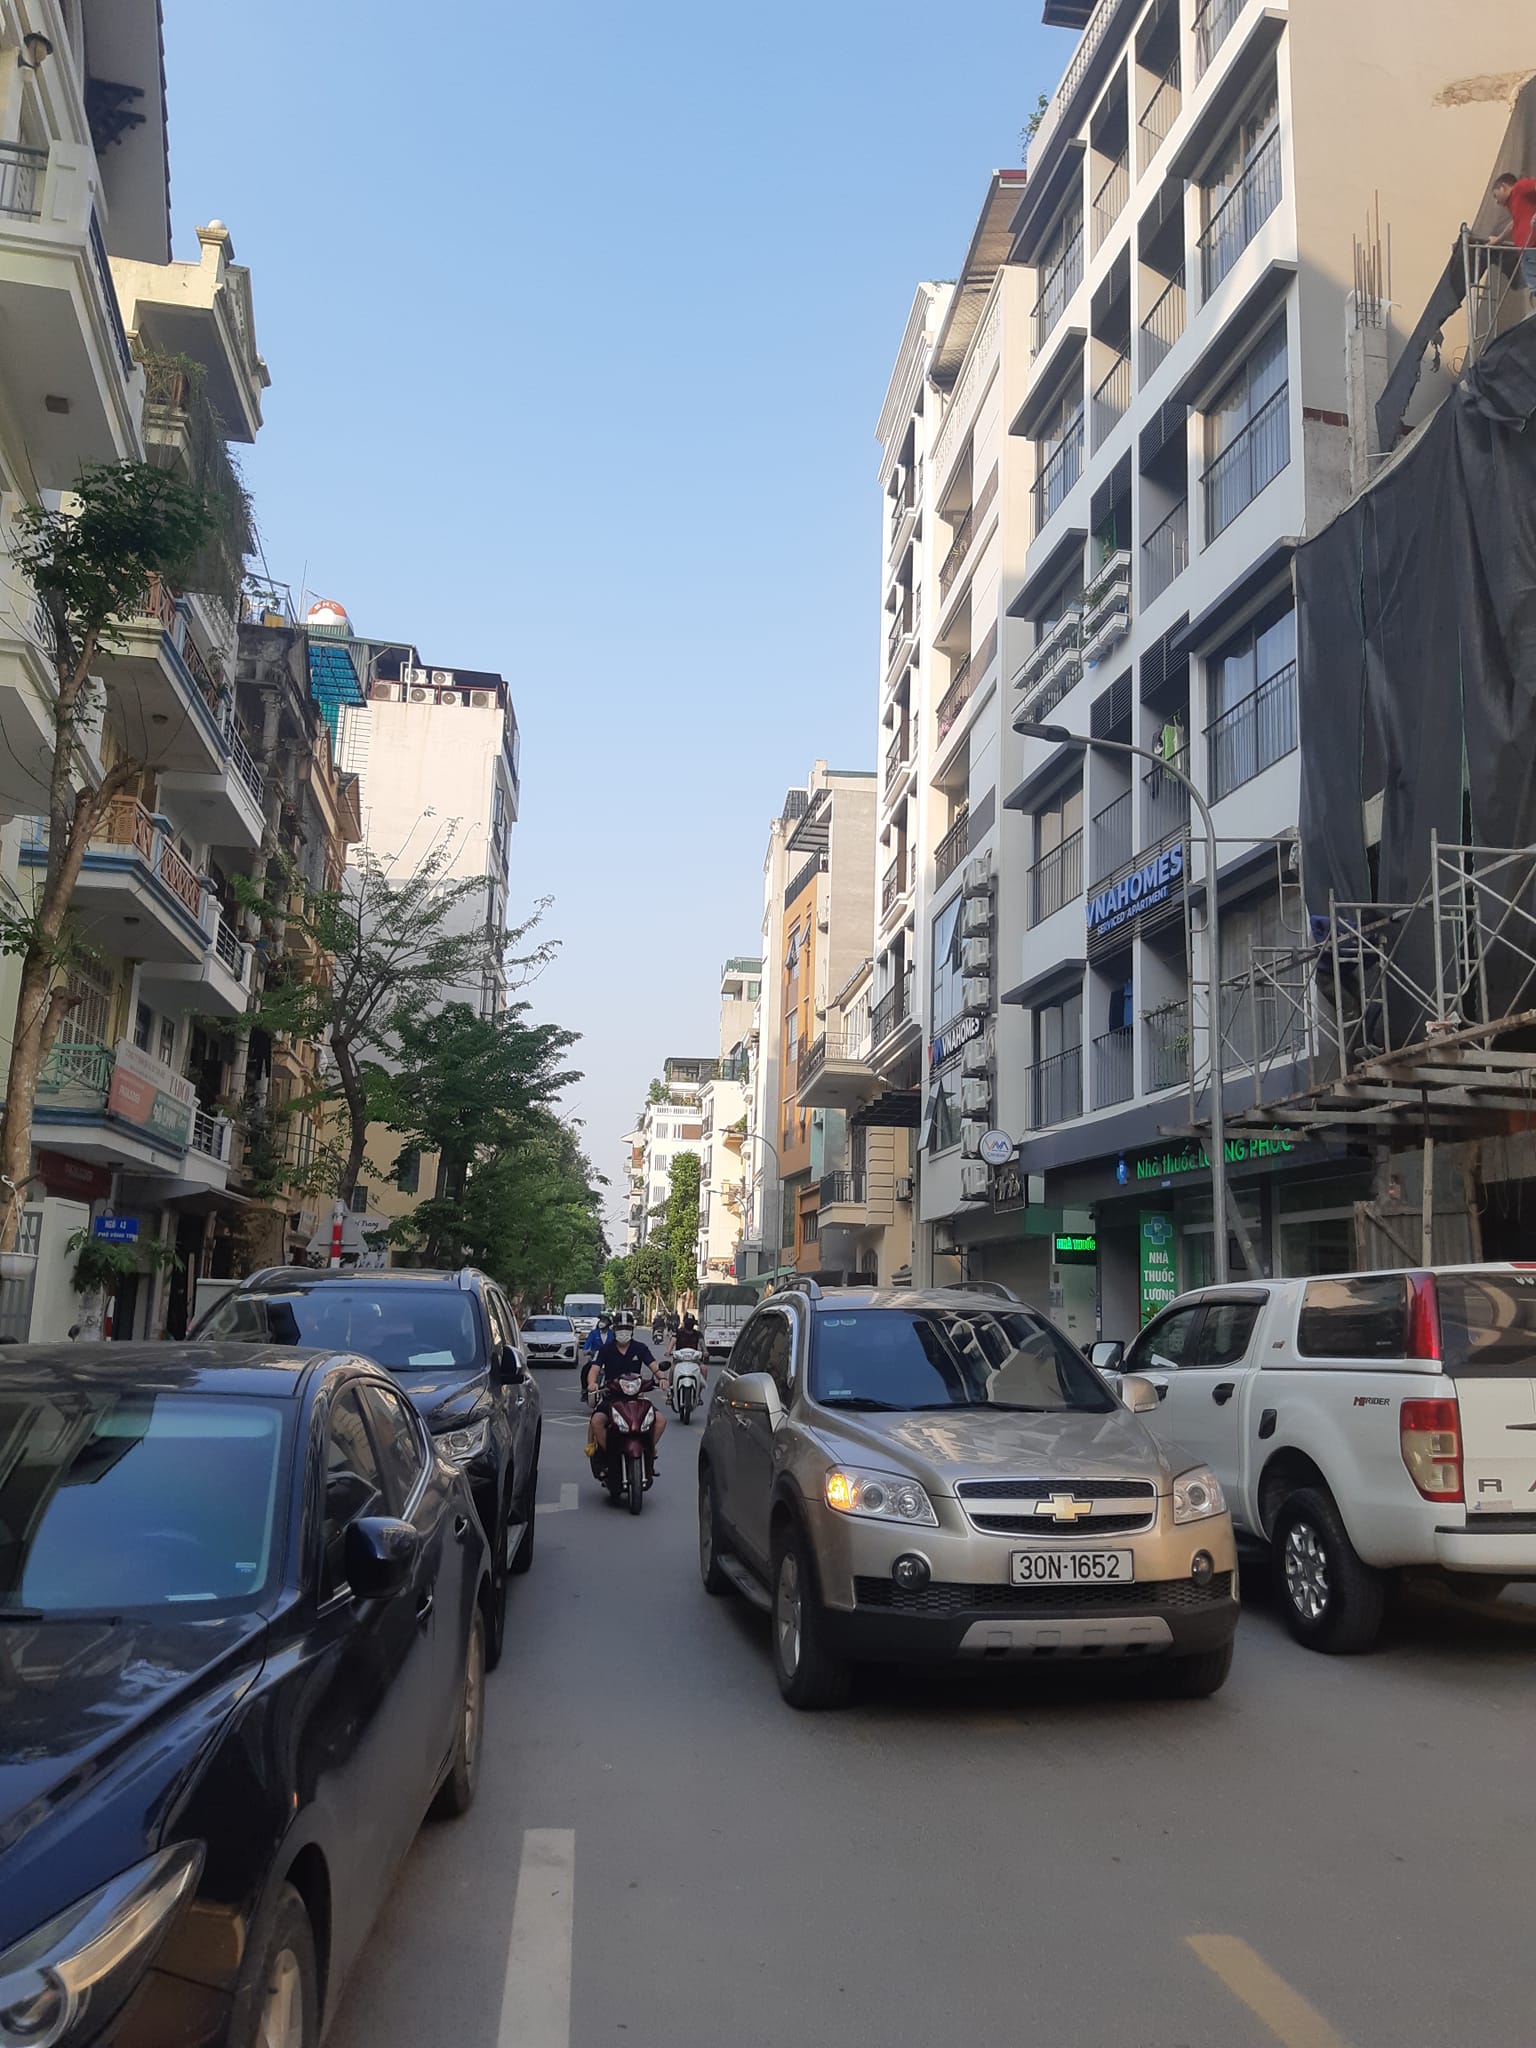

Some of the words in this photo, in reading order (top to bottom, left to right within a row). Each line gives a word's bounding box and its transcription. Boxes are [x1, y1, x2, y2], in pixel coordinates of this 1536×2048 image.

[1085, 842, 1184, 928] VNAHOMES
[1097, 911, 1125, 937] SERVICED
[1126, 885, 1169, 920] APARTMENT
[1137, 1155, 1159, 1179] Nhà
[1161, 1145, 1196, 1175] thuốc
[1056, 1236, 1073, 1250] NHÀ
[1148, 1250, 1169, 1264] NHÀ
[1143, 1266, 1175, 1283] THUỐC
[1143, 1288, 1175, 1301] LƯƠNG
[1019, 1554, 1120, 1580] 30N-1652
